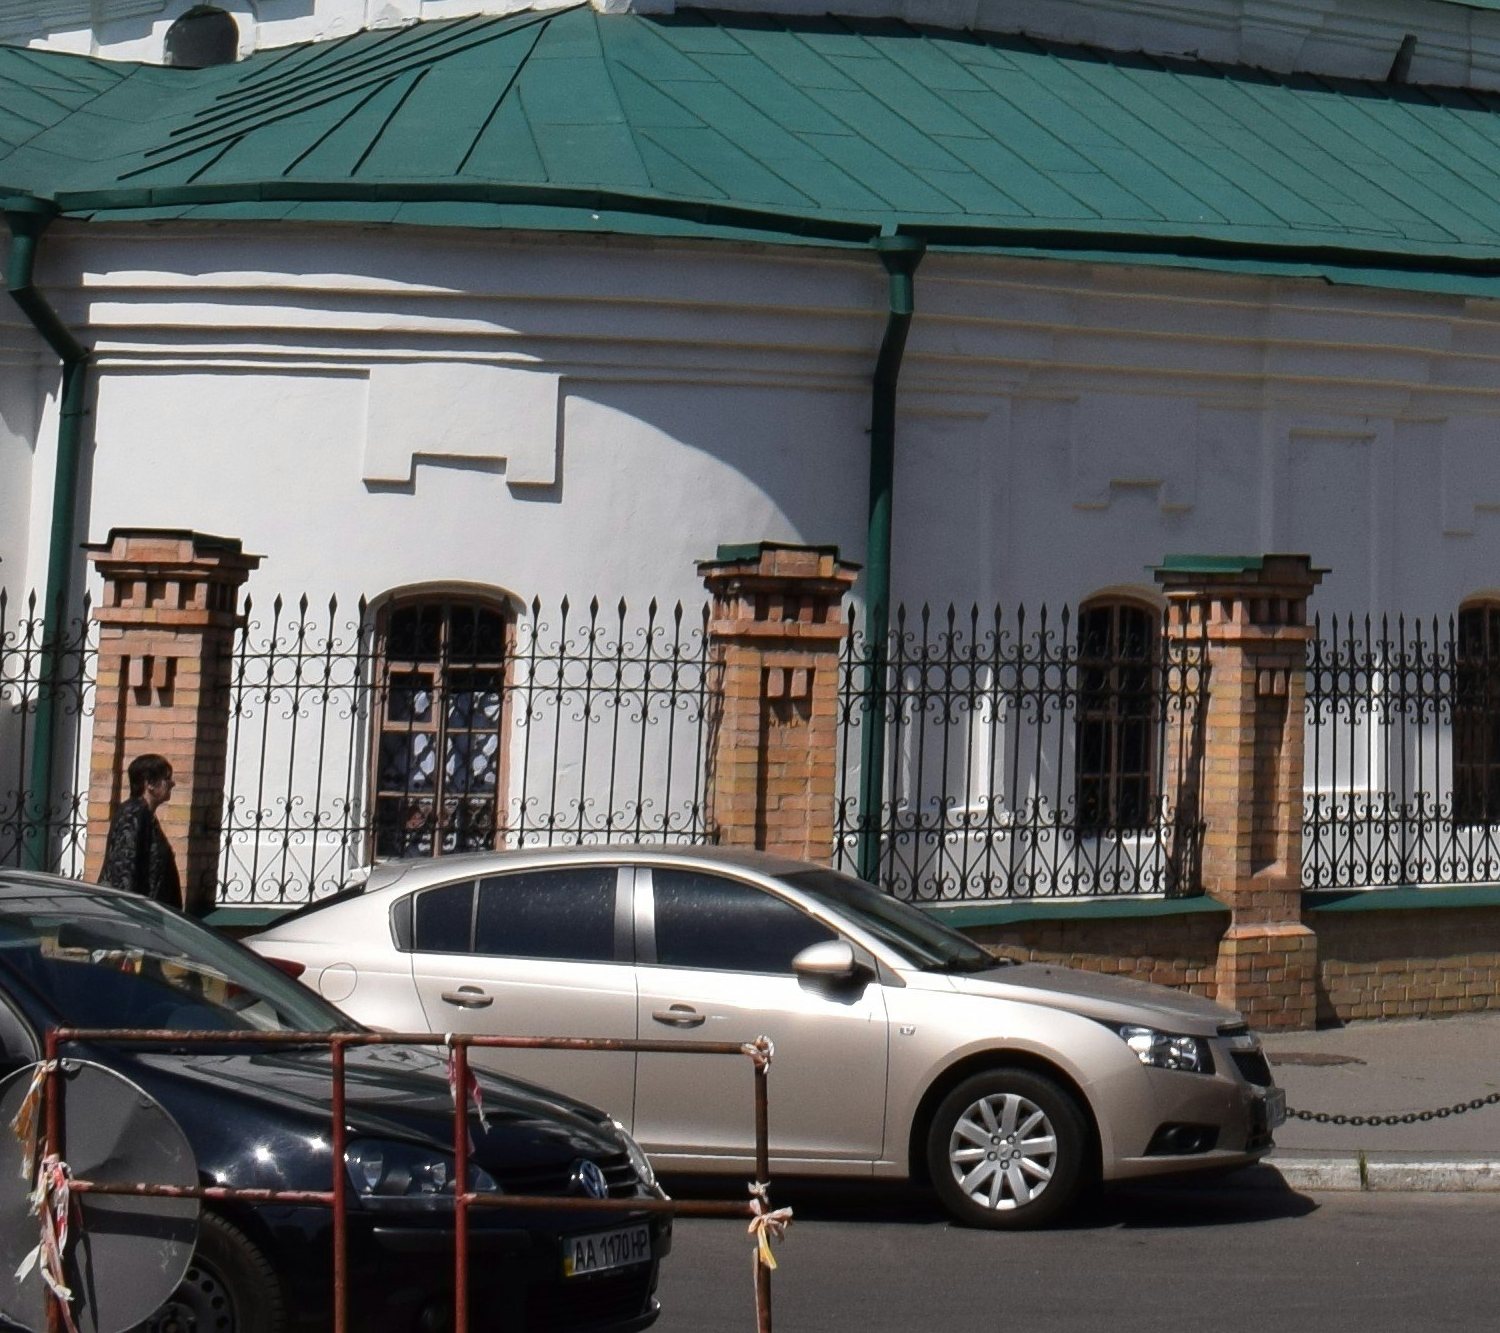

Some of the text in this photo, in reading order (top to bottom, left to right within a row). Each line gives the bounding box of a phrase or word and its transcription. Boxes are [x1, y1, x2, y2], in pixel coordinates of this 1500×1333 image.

[574, 1228, 648, 1271] AA 1170 HP
